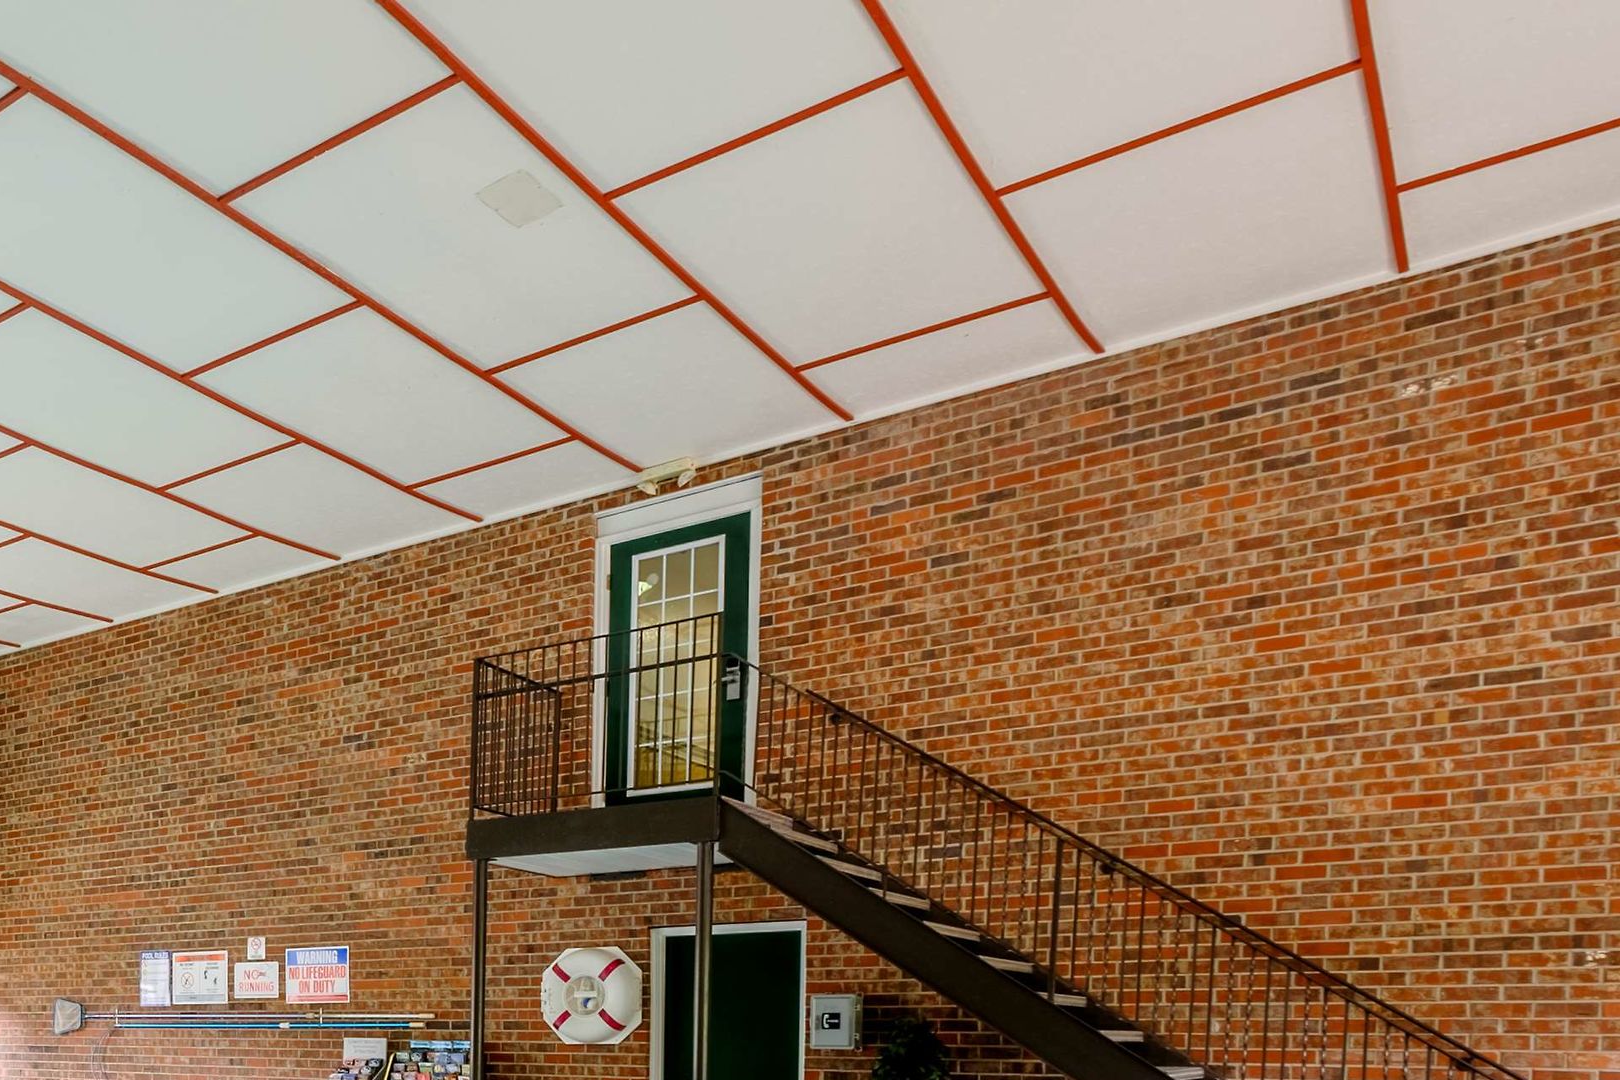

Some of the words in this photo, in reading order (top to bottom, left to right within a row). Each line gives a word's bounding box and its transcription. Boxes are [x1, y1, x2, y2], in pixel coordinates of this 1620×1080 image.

[296, 950, 338, 965] WARNING
[243, 969, 260, 981] NO
[288, 967, 301, 980] NO
[301, 965, 346, 980] LIFEGUARD
[238, 981, 275, 993] RUNNING
[298, 980, 311, 993] ON
[313, 979, 336, 993] DUTY
